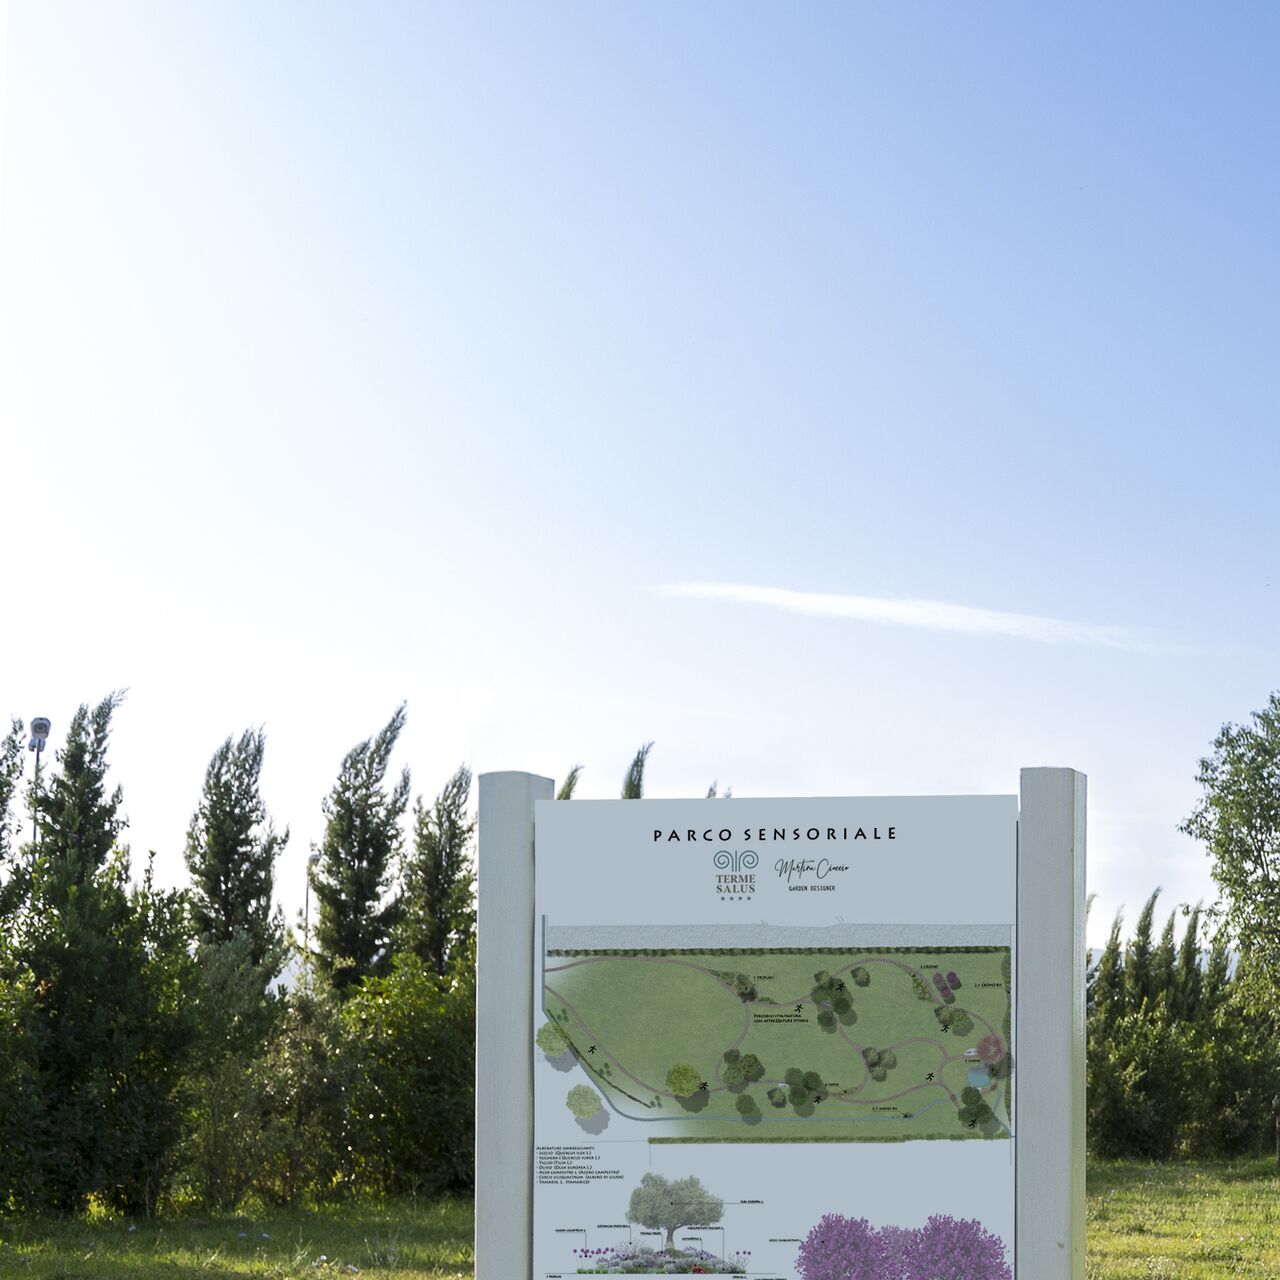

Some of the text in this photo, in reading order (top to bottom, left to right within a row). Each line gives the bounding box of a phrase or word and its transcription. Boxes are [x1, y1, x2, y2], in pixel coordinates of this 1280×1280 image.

[653, 826, 897, 842] PARCO SENSORIALE
[716, 874, 756, 884] TERME
[716, 884, 756, 894] SALUS
